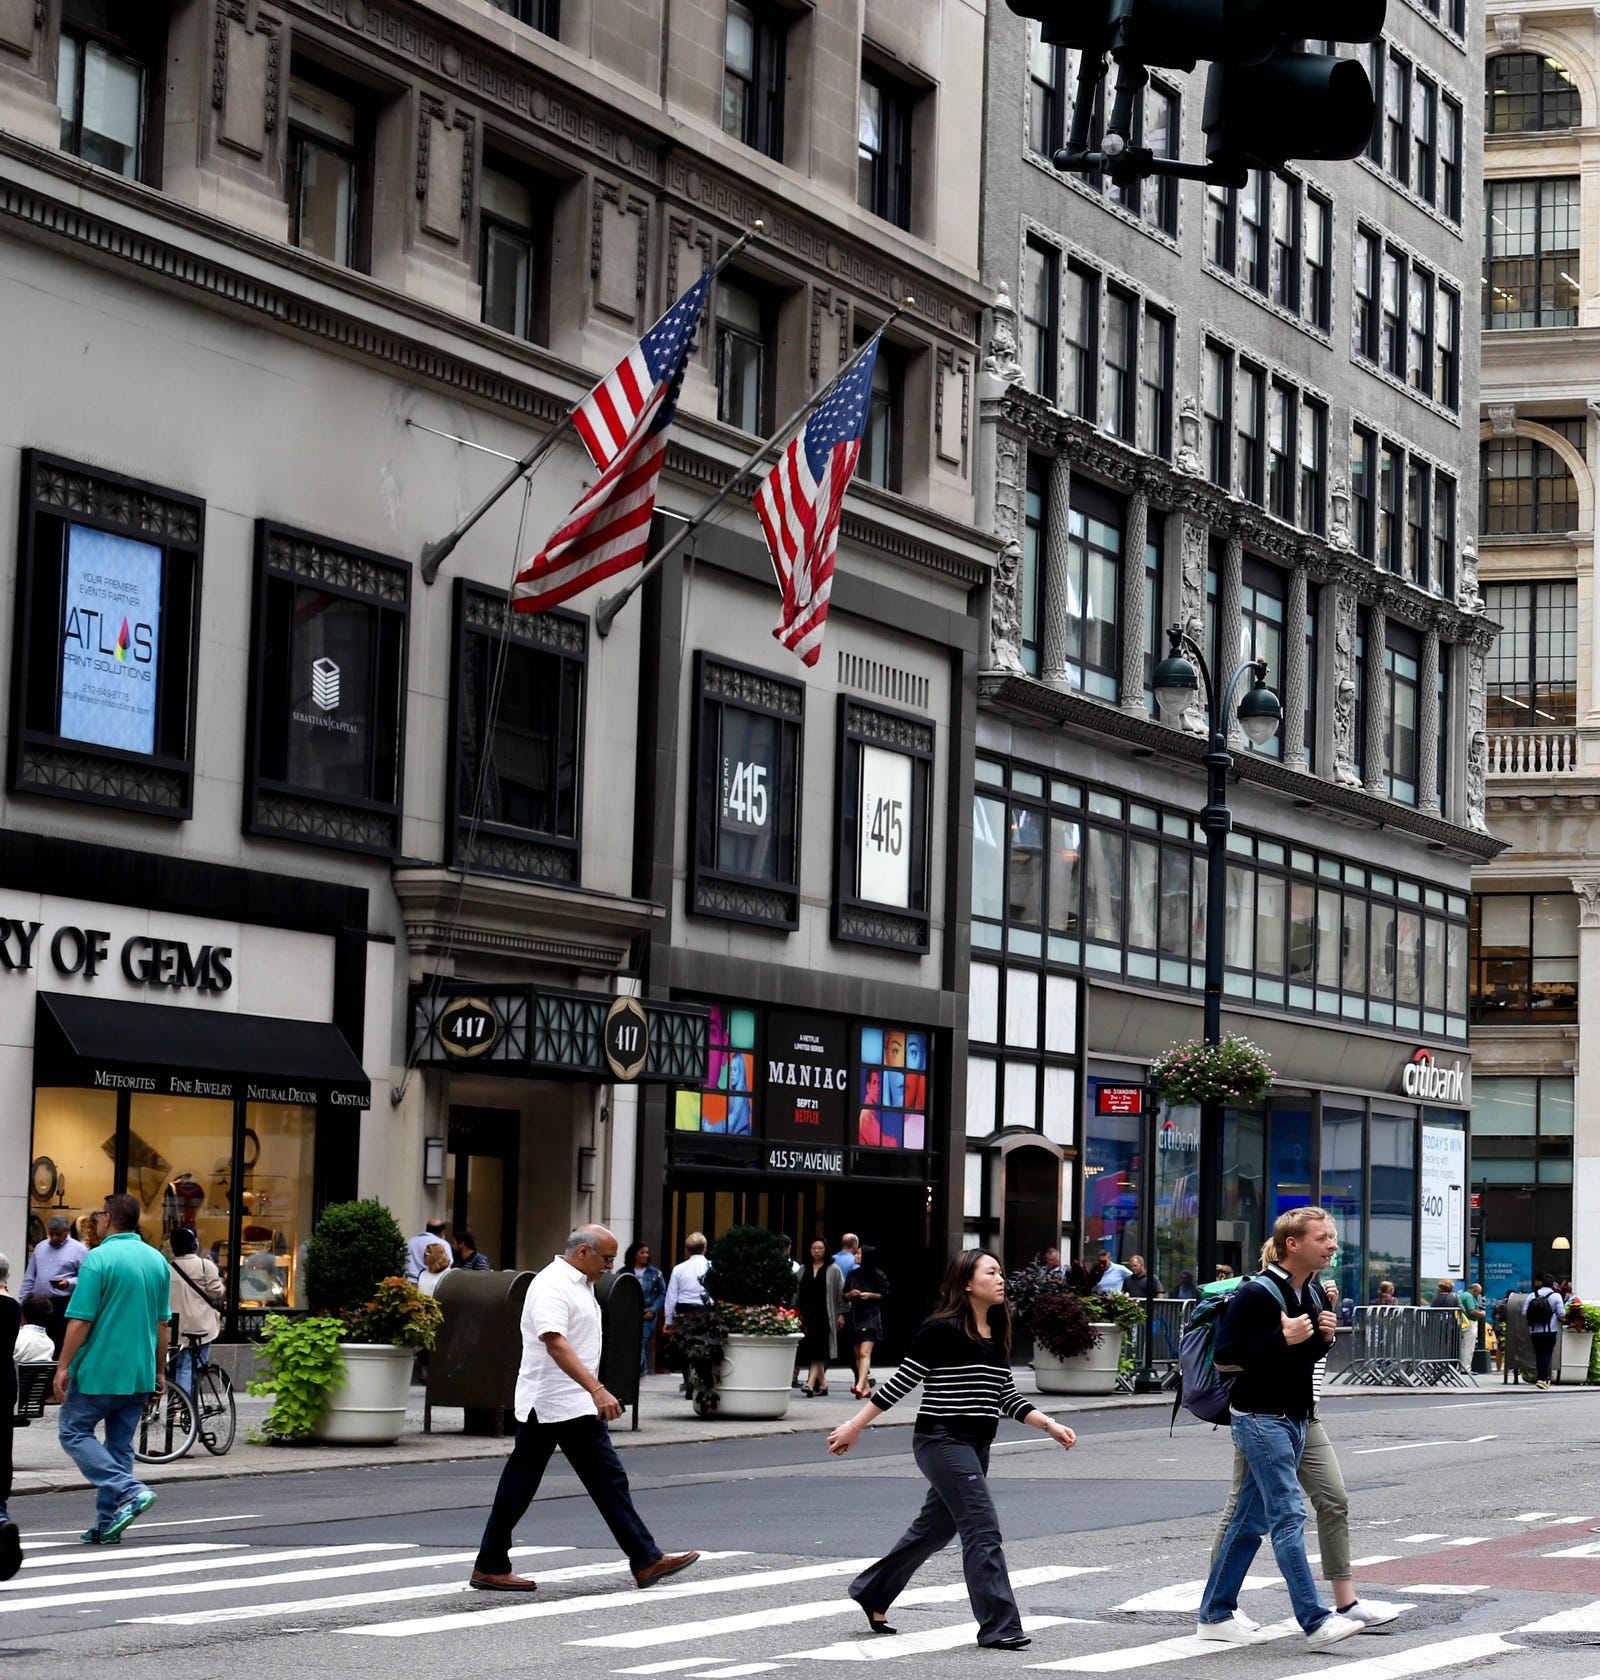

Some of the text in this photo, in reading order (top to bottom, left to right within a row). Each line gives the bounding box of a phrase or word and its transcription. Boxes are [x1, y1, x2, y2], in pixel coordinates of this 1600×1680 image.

[63, 652, 152, 682] PRINT SOLUTIONS
[292, 711, 358, 734] SEBASTIAN CAPITAL
[729, 761, 768, 826] 415
[871, 796, 903, 857] 415
[51, 925, 111, 978] OF
[120, 935, 233, 992] GEMS
[451, 1016, 486, 1039] 417
[614, 1024, 639, 1053] 417
[93, 1069, 371, 1107] METEORITES FINE JEWELRY NATURAL DECOR CRYSTALS
[768, 1060, 847, 1091] MANIAC
[1402, 1055, 1465, 1102] citibank
[794, 1108, 820, 1126] NETFLIX
[796, 1098, 819, 1110] SEPT 21
[1158, 1125, 1200, 1152] citibank
[769, 1150, 788, 1168] 415
[803, 1152, 843, 1172] AVENUE
